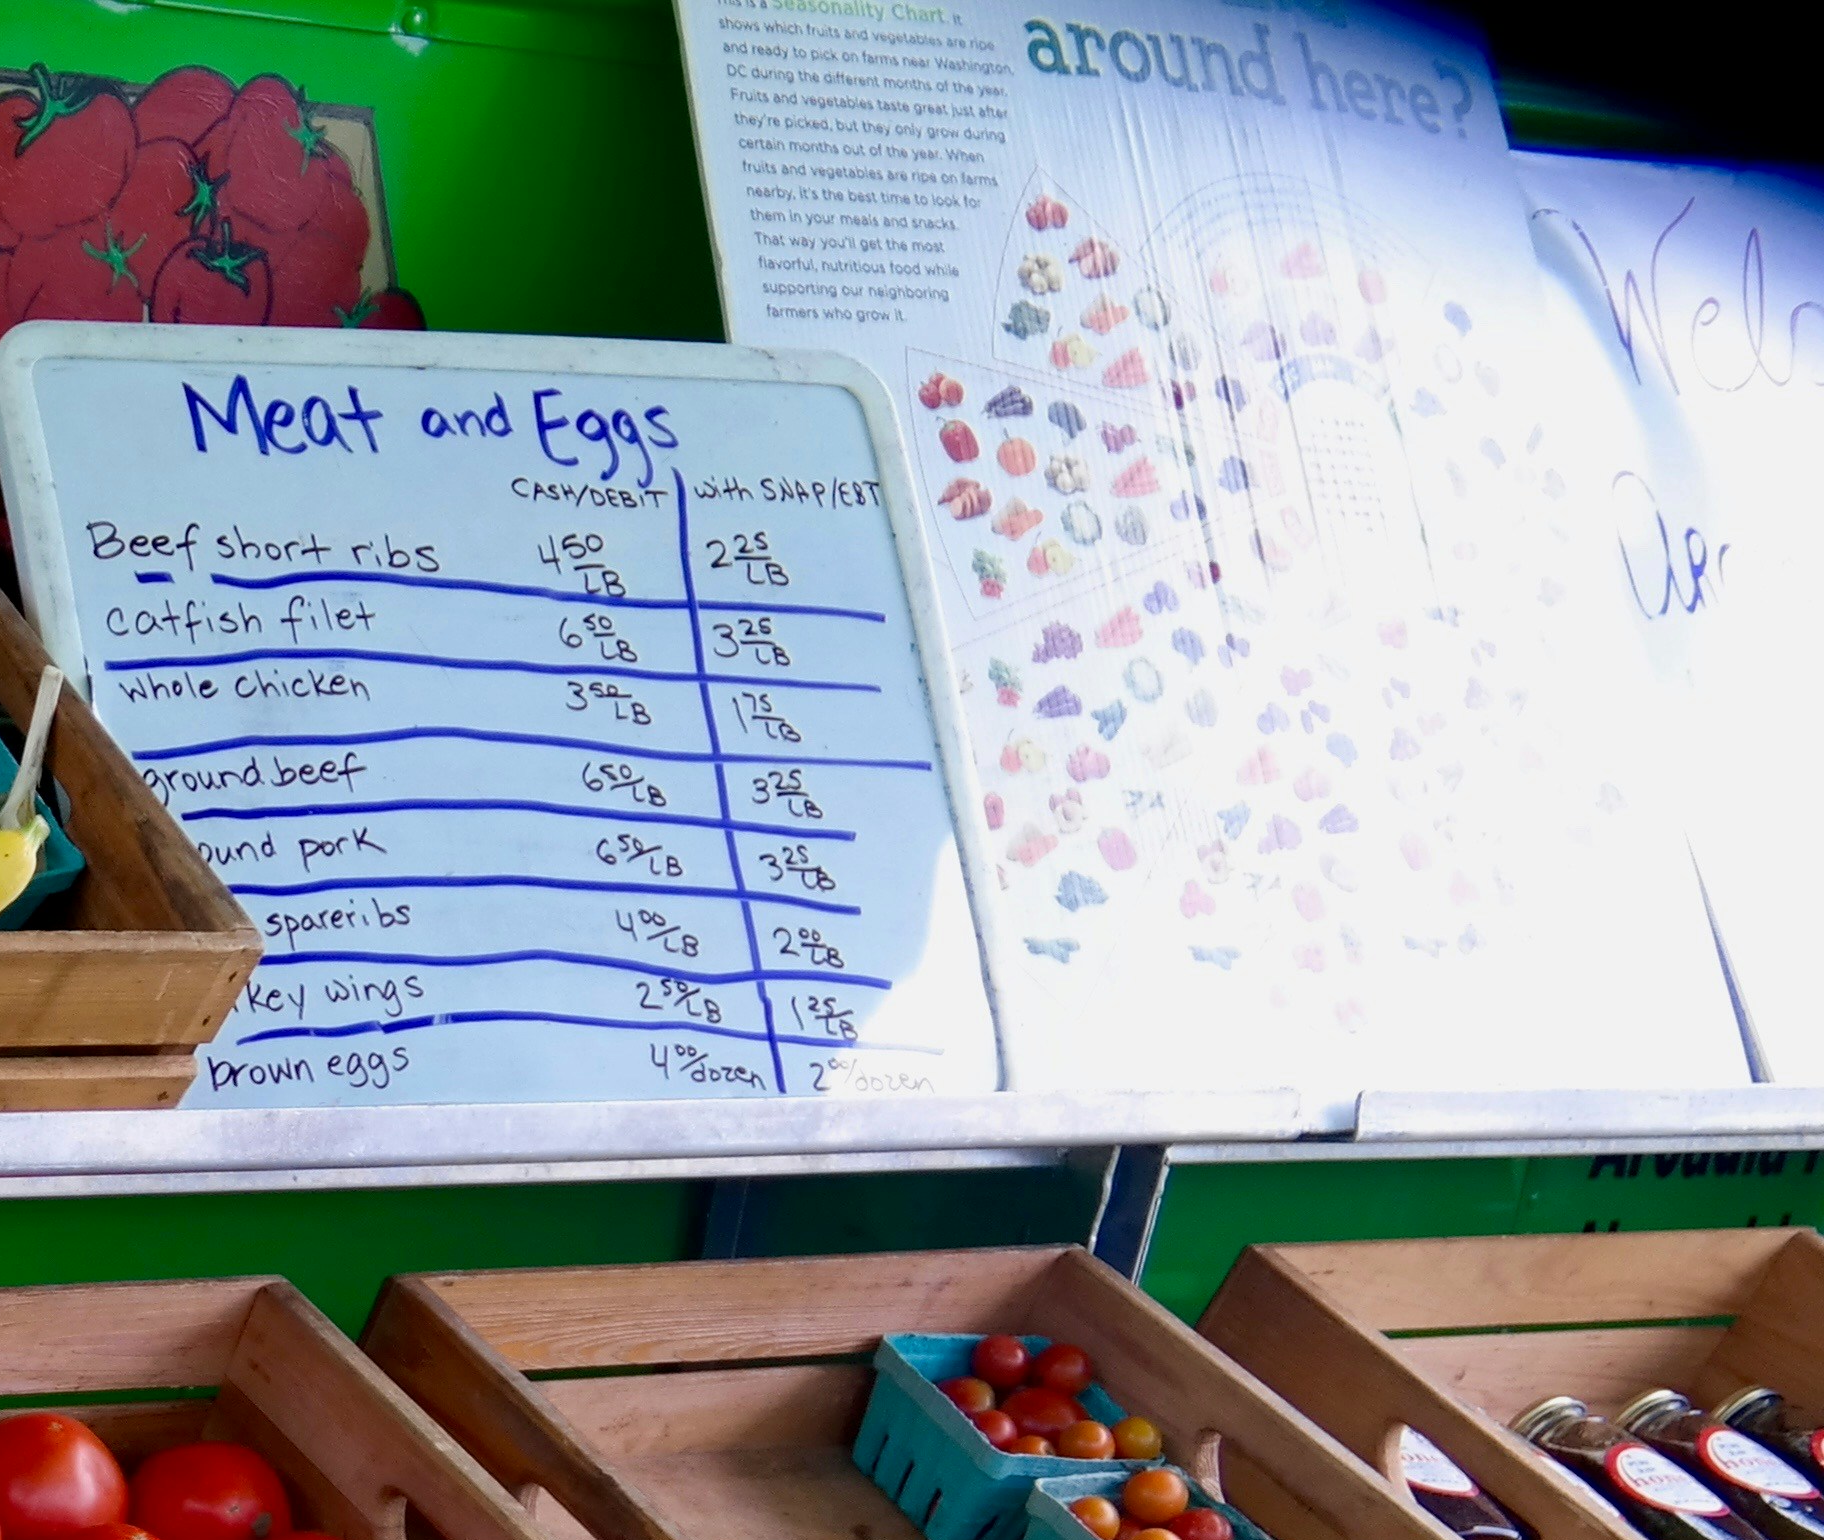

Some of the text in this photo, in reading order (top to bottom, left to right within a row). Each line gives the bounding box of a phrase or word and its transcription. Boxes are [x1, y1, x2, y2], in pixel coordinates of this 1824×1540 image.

[772, 0, 884, 22] Seasonality
[719, 16, 995, 51] shows which fruits and vegetables are ripe
[723, 42, 747, 55] and
[752, 43, 788, 60] ready
[793, 46, 807, 59] to
[811, 48, 838, 62] pick
[842, 52, 859, 63] on
[862, 51, 899, 66] farms
[903, 56, 930, 68] near
[727, 63, 747, 78] DC
[751, 65, 794, 83] during
[798, 69, 820, 83] the
[824, 71, 880, 88] different
[883, 76, 932, 92] months
[936, 80, 949, 92] of
[952, 81, 974, 94] the
[1024, 17, 1474, 140] around here?
[730, 87, 1008, 119] Fruits and vegetables taste great just after
[734, 111, 780, 128] they're
[835, 118, 859, 133] but
[862, 119, 890, 136] they
[895, 123, 922, 138] only
[926, 126, 959, 140] grow
[964, 126, 1006, 144] during
[738, 136, 785, 151] certain
[789, 139, 839, 154] months
[843, 143, 866, 156] out
[869, 143, 882, 157] of
[886, 144, 908, 159] the
[946, 148, 986, 163] When
[742, 160, 998, 187] fruits and vegetables are ripe on farms
[799, 187, 819, 201] it's
[822, 188, 844, 202] the
[848, 190, 878, 204] best
[881, 192, 910, 206] time
[914, 194, 929, 207] to
[932, 194, 959, 208] look
[962, 195, 982, 209] for
[750, 209, 785, 223] them
[790, 210, 802, 223] in
[805, 214, 835, 228] your
[840, 214, 879, 227] meals
[883, 216, 908, 229] and
[754, 231, 945, 253] That way you'll get the most
[822, 260, 886, 275] nutritious
[889, 260, 921, 276] food
[924, 263, 959, 277] while
[763, 280, 949, 302] supporting our neighboring
[767, 304, 819, 320] farmers
[822, 307, 852, 320] who
[856, 309, 890, 323] grow
[181, 373, 679, 489] Meat and Eggs
[511, 477, 669, 509] CASH/DEBIT
[694, 477, 754, 501] with
[86, 520, 200, 572] Beef
[216, 525, 332, 566] short
[351, 533, 441, 573] ribs
[105, 599, 263, 645] catfish
[280, 595, 376, 645] filet
[119, 670, 219, 702] whole
[235, 668, 371, 702] chicken
[142, 756, 267, 807] ground
[270, 751, 368, 793] beef
[298, 826, 388, 874] pork
[265, 897, 412, 952] spareribs
[324, 973, 425, 1018] wings
[206, 1055, 315, 1092] brown
[327, 1045, 411, 1090] eggs
